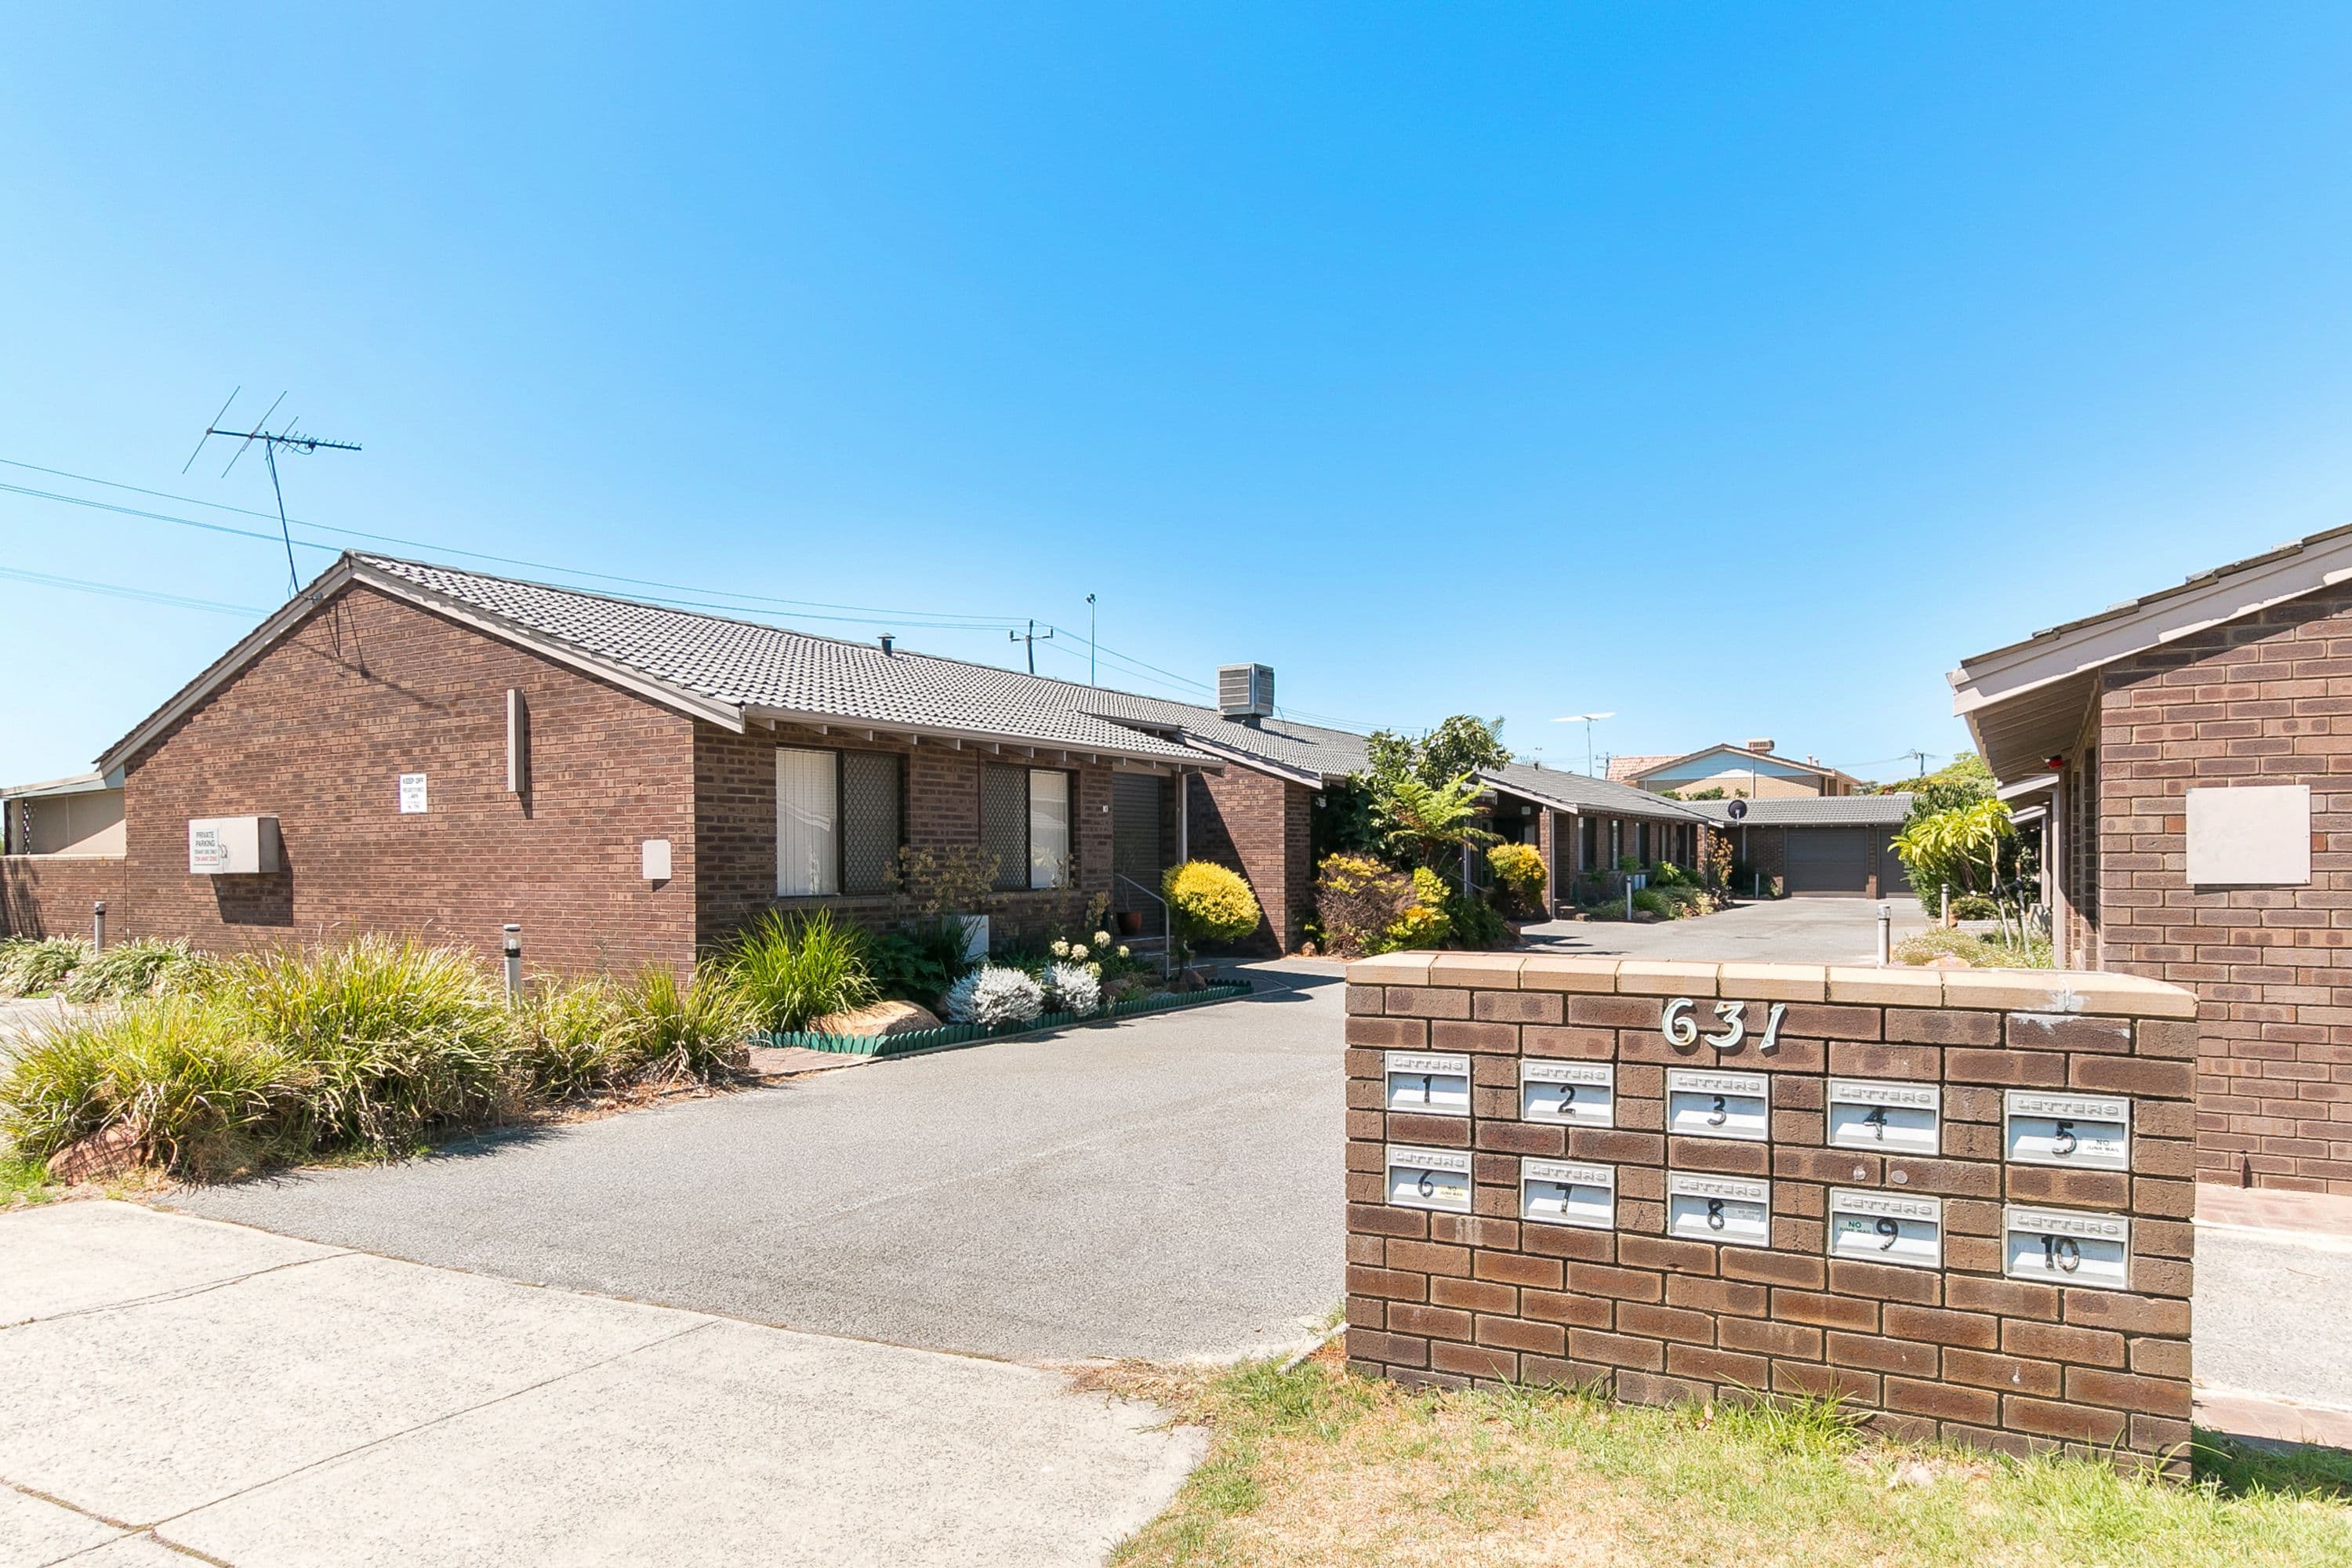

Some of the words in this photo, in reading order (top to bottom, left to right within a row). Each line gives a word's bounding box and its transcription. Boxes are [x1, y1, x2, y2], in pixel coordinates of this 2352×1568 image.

[1661, 997, 1786, 1049] 631
[1393, 1058, 1463, 1071] LETTERS
[1530, 1065, 1606, 1080] LETTERS
[1423, 1075, 1432, 1104] 1
[1678, 1075, 1760, 1091] LETTERS
[1838, 1085, 1931, 1104] LETTERS
[1557, 1085, 1576, 1114] 2
[1707, 1096, 1726, 1126] 3
[2016, 1098, 2118, 1116] LETTERS
[1863, 1106, 1887, 1141] 4
[2052, 1121, 2077, 1155] 5
[1395, 1151, 1464, 1167] LETTERS
[1530, 1164, 1606, 1181] LETTERS
[1417, 1170, 1433, 1197] 6
[1678, 1178, 1761, 1197] LETTERS
[1555, 1183, 1573, 1213] 7
[1839, 1195, 1932, 1215] LETTERS
[1708, 1198, 1725, 1230] 8
[2016, 1214, 2118, 1234] LETTERS
[1876, 1217, 1898, 1250] 9
[2041, 1235, 2080, 1272] 10
